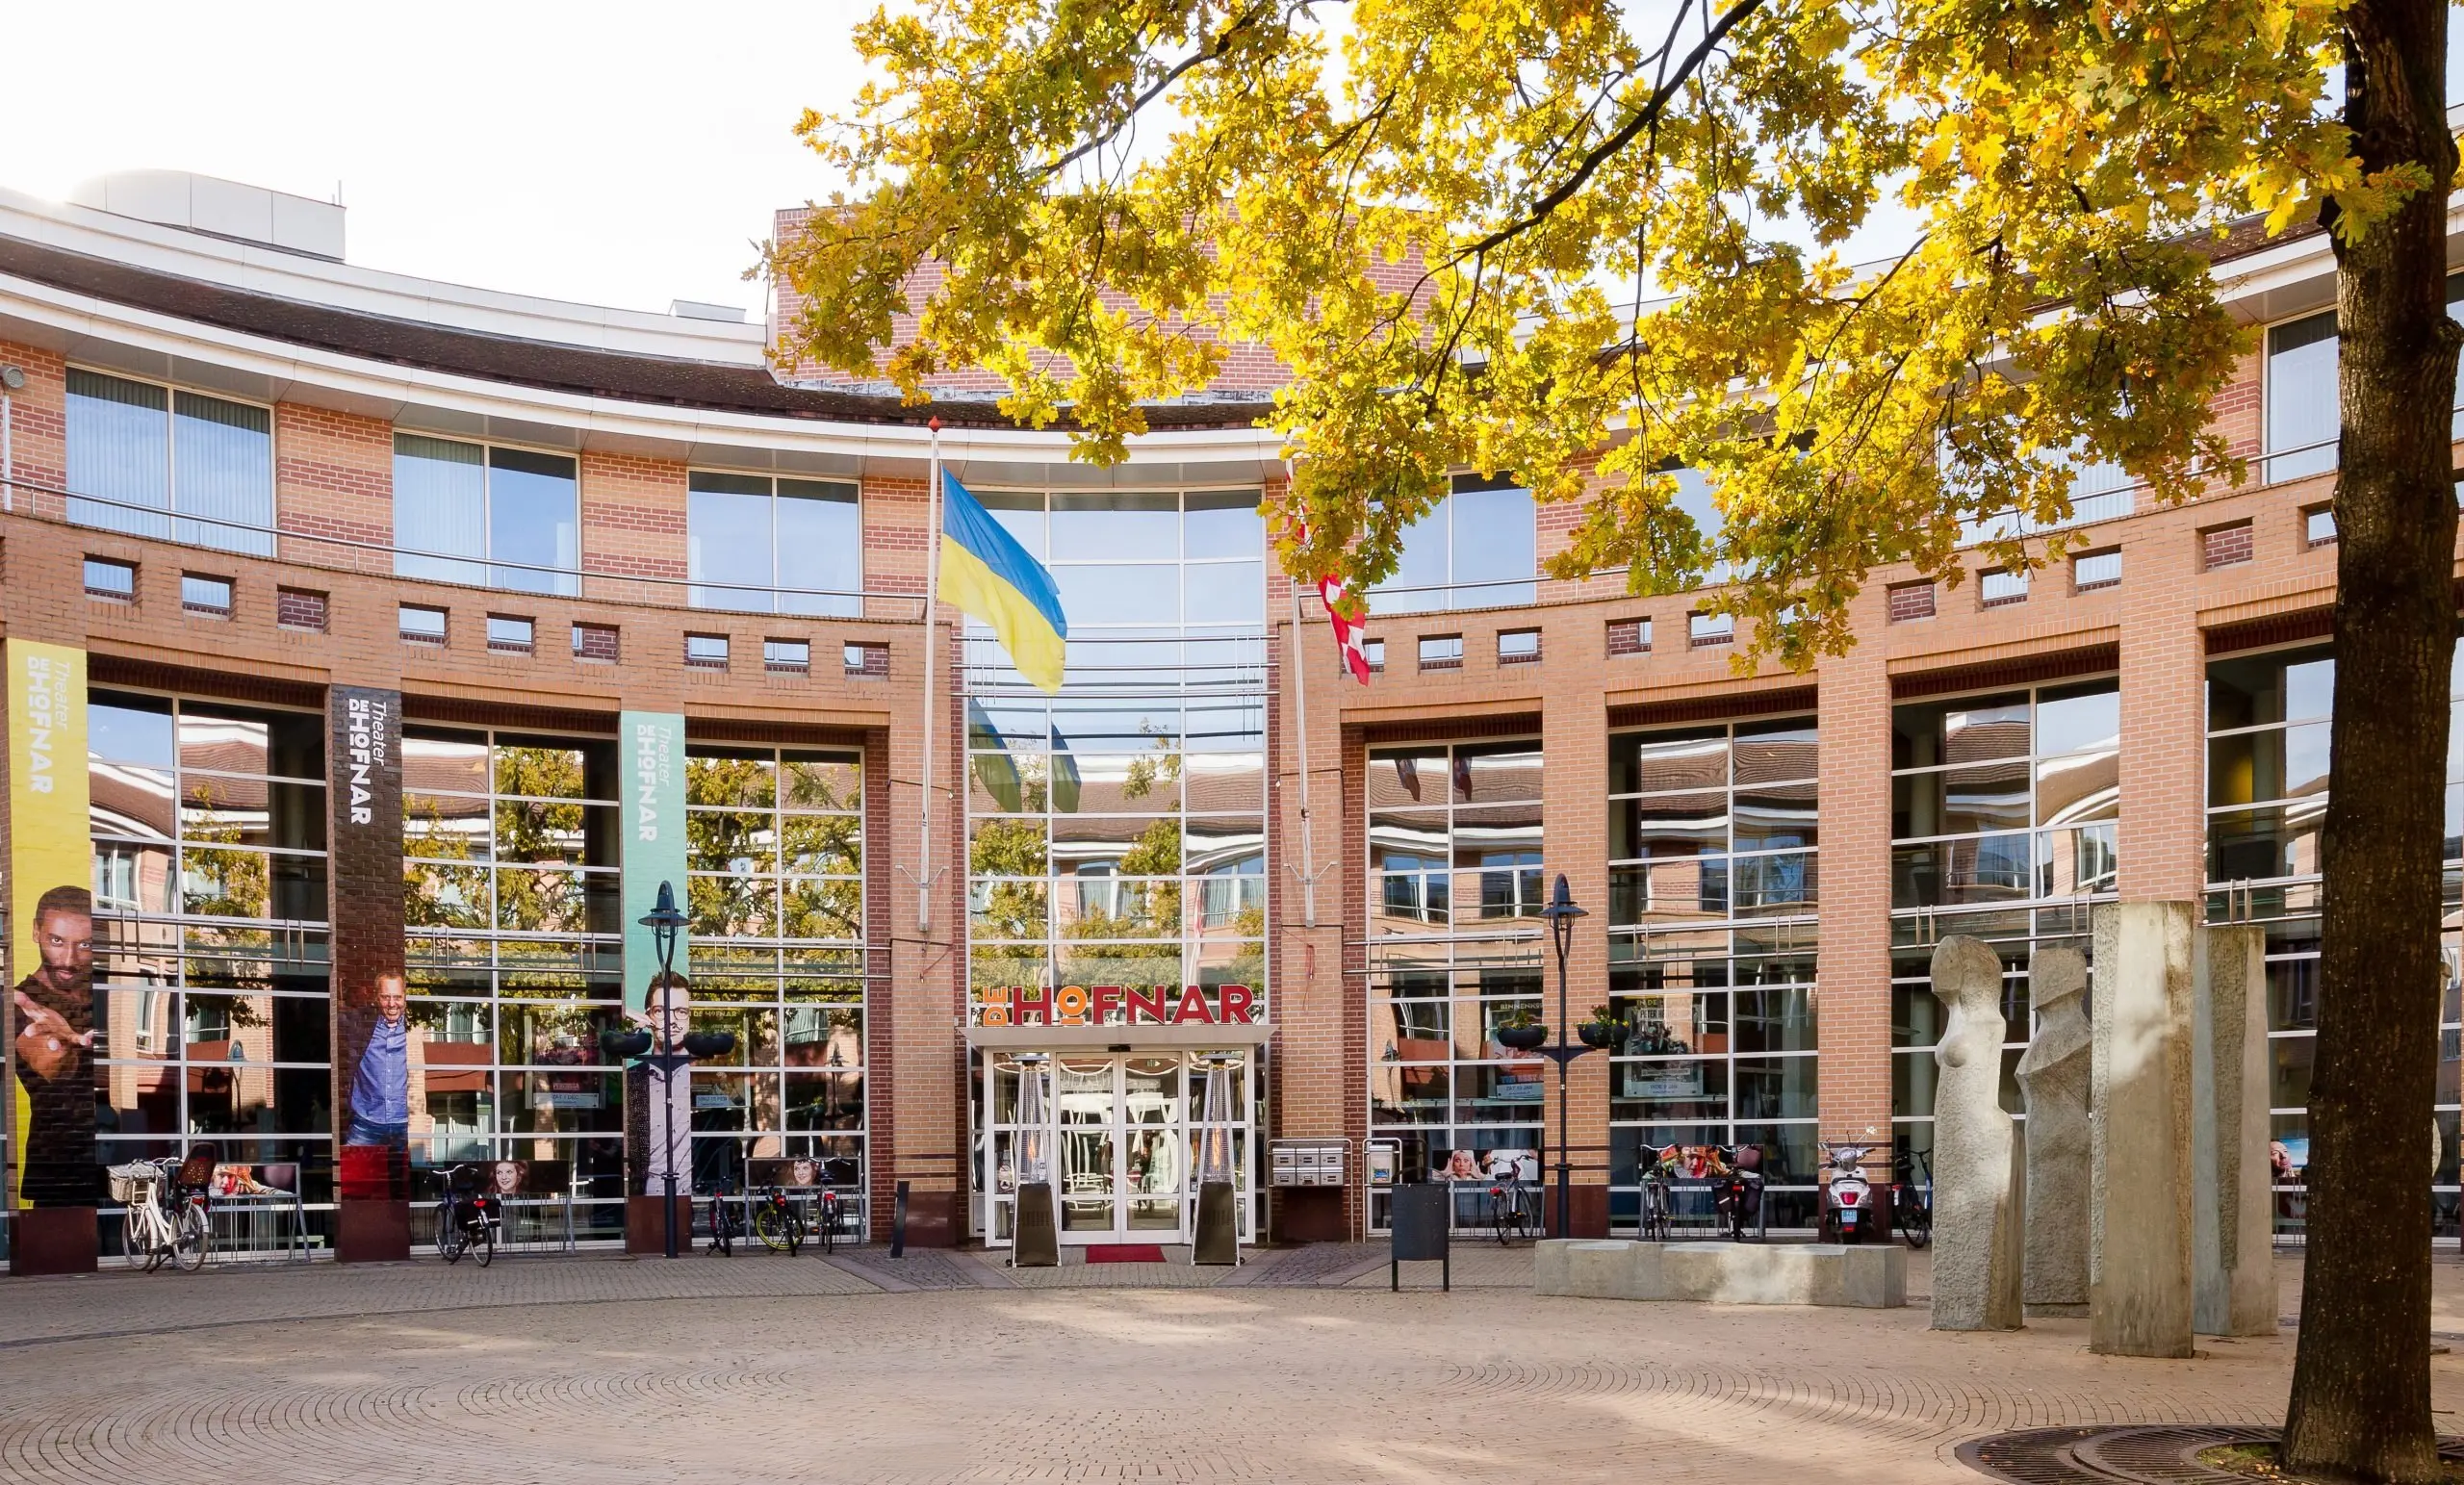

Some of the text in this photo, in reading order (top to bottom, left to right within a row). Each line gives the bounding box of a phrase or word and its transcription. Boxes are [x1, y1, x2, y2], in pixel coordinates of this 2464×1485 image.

[28, 655, 53, 793] DE HOFNAR
[55, 662, 70, 730] Theater
[349, 699, 372, 825] DE HOFNAR
[372, 702, 387, 766] Theater
[659, 727, 672, 786] Theater
[637, 725, 657, 841] DE HOFNAR
[983, 985, 1253, 1026] DE HOFNAR
